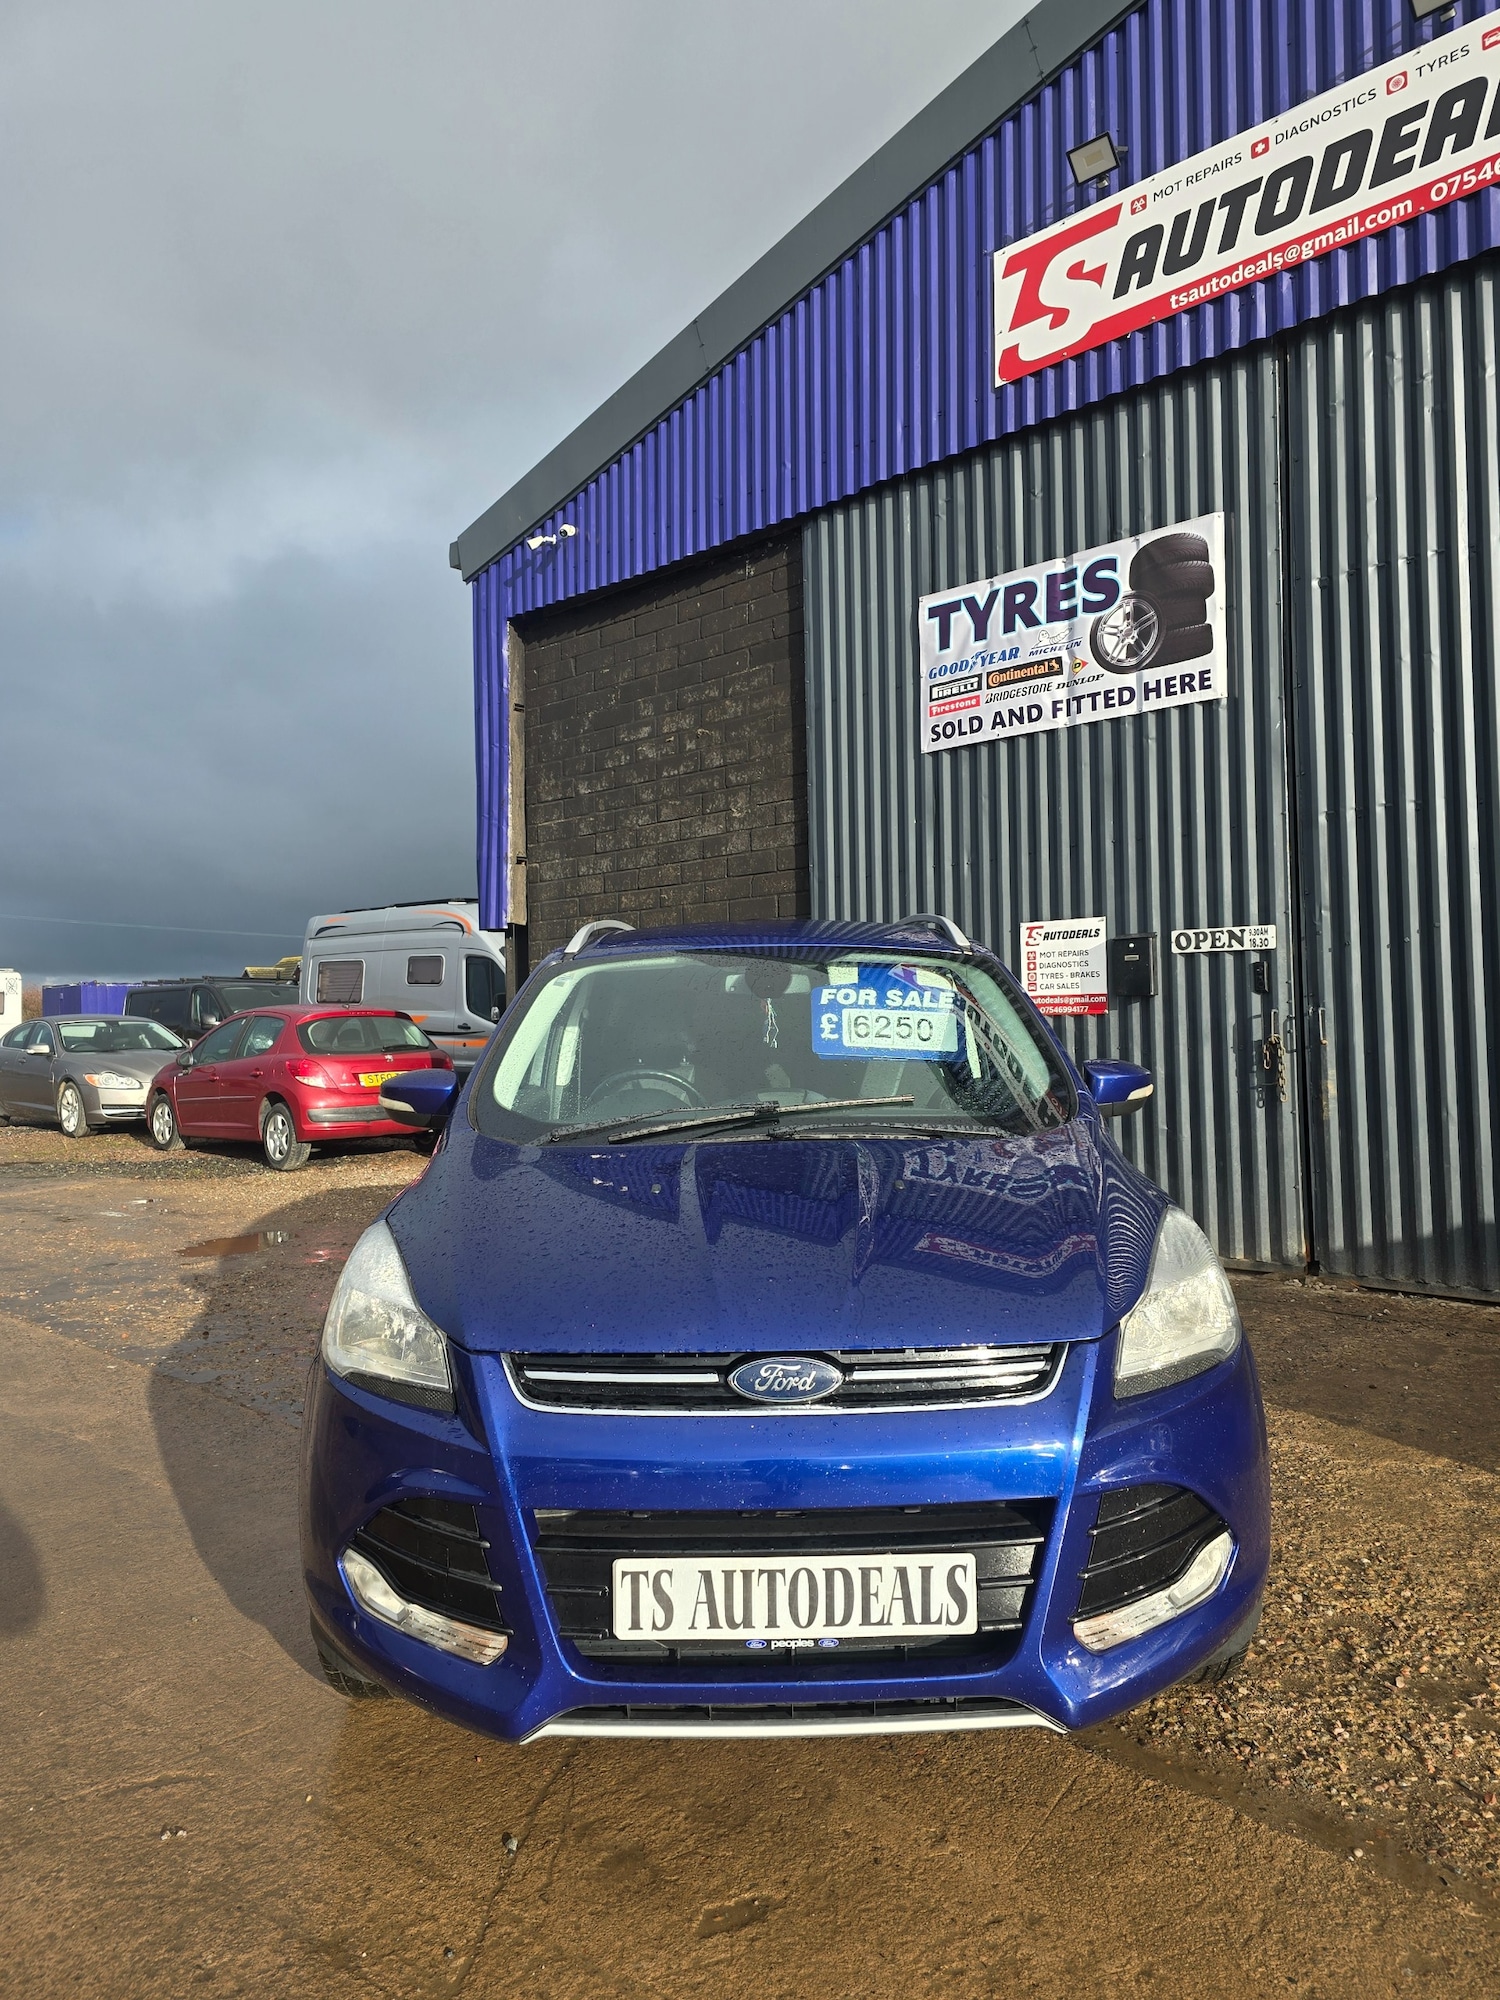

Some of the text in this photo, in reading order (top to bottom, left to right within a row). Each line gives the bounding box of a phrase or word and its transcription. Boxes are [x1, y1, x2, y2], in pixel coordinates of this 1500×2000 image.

[1153, 44, 1470, 202] MOT REPAIRS DIAGNOSTICS TYRES
[1169, 199, 1413, 310] tsautodeals@gmail.com
[927, 557, 1121, 652] TYRES
[1028, 640, 1082, 657] MICHELIN
[928, 646, 1021, 680] GOODYEAR
[988, 661, 1049, 687] Continental
[932, 676, 979, 699] PIRELLI
[1056, 674, 1105, 689] DUNLOP
[985, 682, 1053, 705] BRIDGESTONE
[930, 669, 1212, 743] SOLD AND FITTED HERE
[931, 698, 978, 715] Firestone
[1043, 928, 1100, 941] AUTODEALS
[1175, 929, 1246, 951] OPEN
[1039, 960, 1089, 969] DIAGNOSTICS
[1058, 949, 1089, 958] REPAIRS
[1070, 971, 1100, 979] BRAKES
[820, 988, 956, 1009] FOR SALE
[1040, 1006, 1089, 1014] 07546994177
[853, 1015, 933, 1042] 6250
[754, 1364, 817, 1391] Ford
[620, 1563, 968, 1632] TS AUTODEALS
[770, 1638, 815, 1650] peoples
